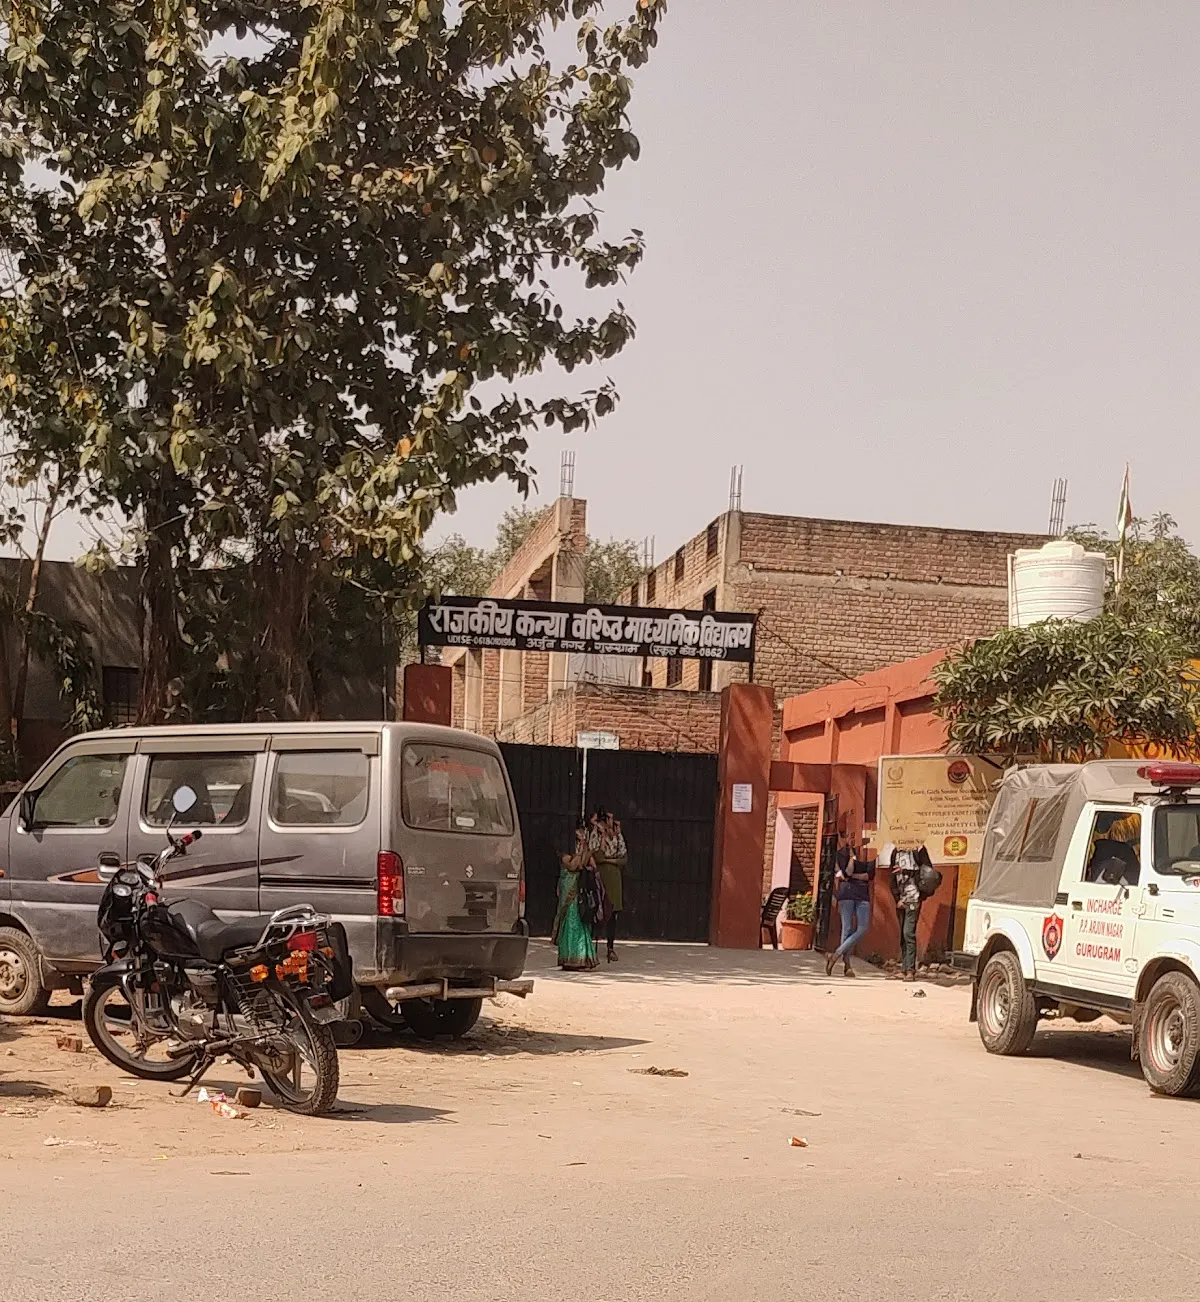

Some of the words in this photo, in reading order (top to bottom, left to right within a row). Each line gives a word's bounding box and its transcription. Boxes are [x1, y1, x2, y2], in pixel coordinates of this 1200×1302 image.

[428, 601, 514, 635] राजकीय
[515, 610, 569, 638] कन्या
[571, 608, 624, 641] वरिष्ठ
[624, 613, 699, 646] माध्यमिक
[699, 615, 753, 648] विद्यालय
[526, 636, 556, 650] अर्जुन
[1087, 899, 1123, 915] INCHARGE
[1089, 920, 1105, 936] ARJUN
[1105, 921, 1124, 939] NAGAR
[1076, 943, 1121, 962] GURUGRAM
